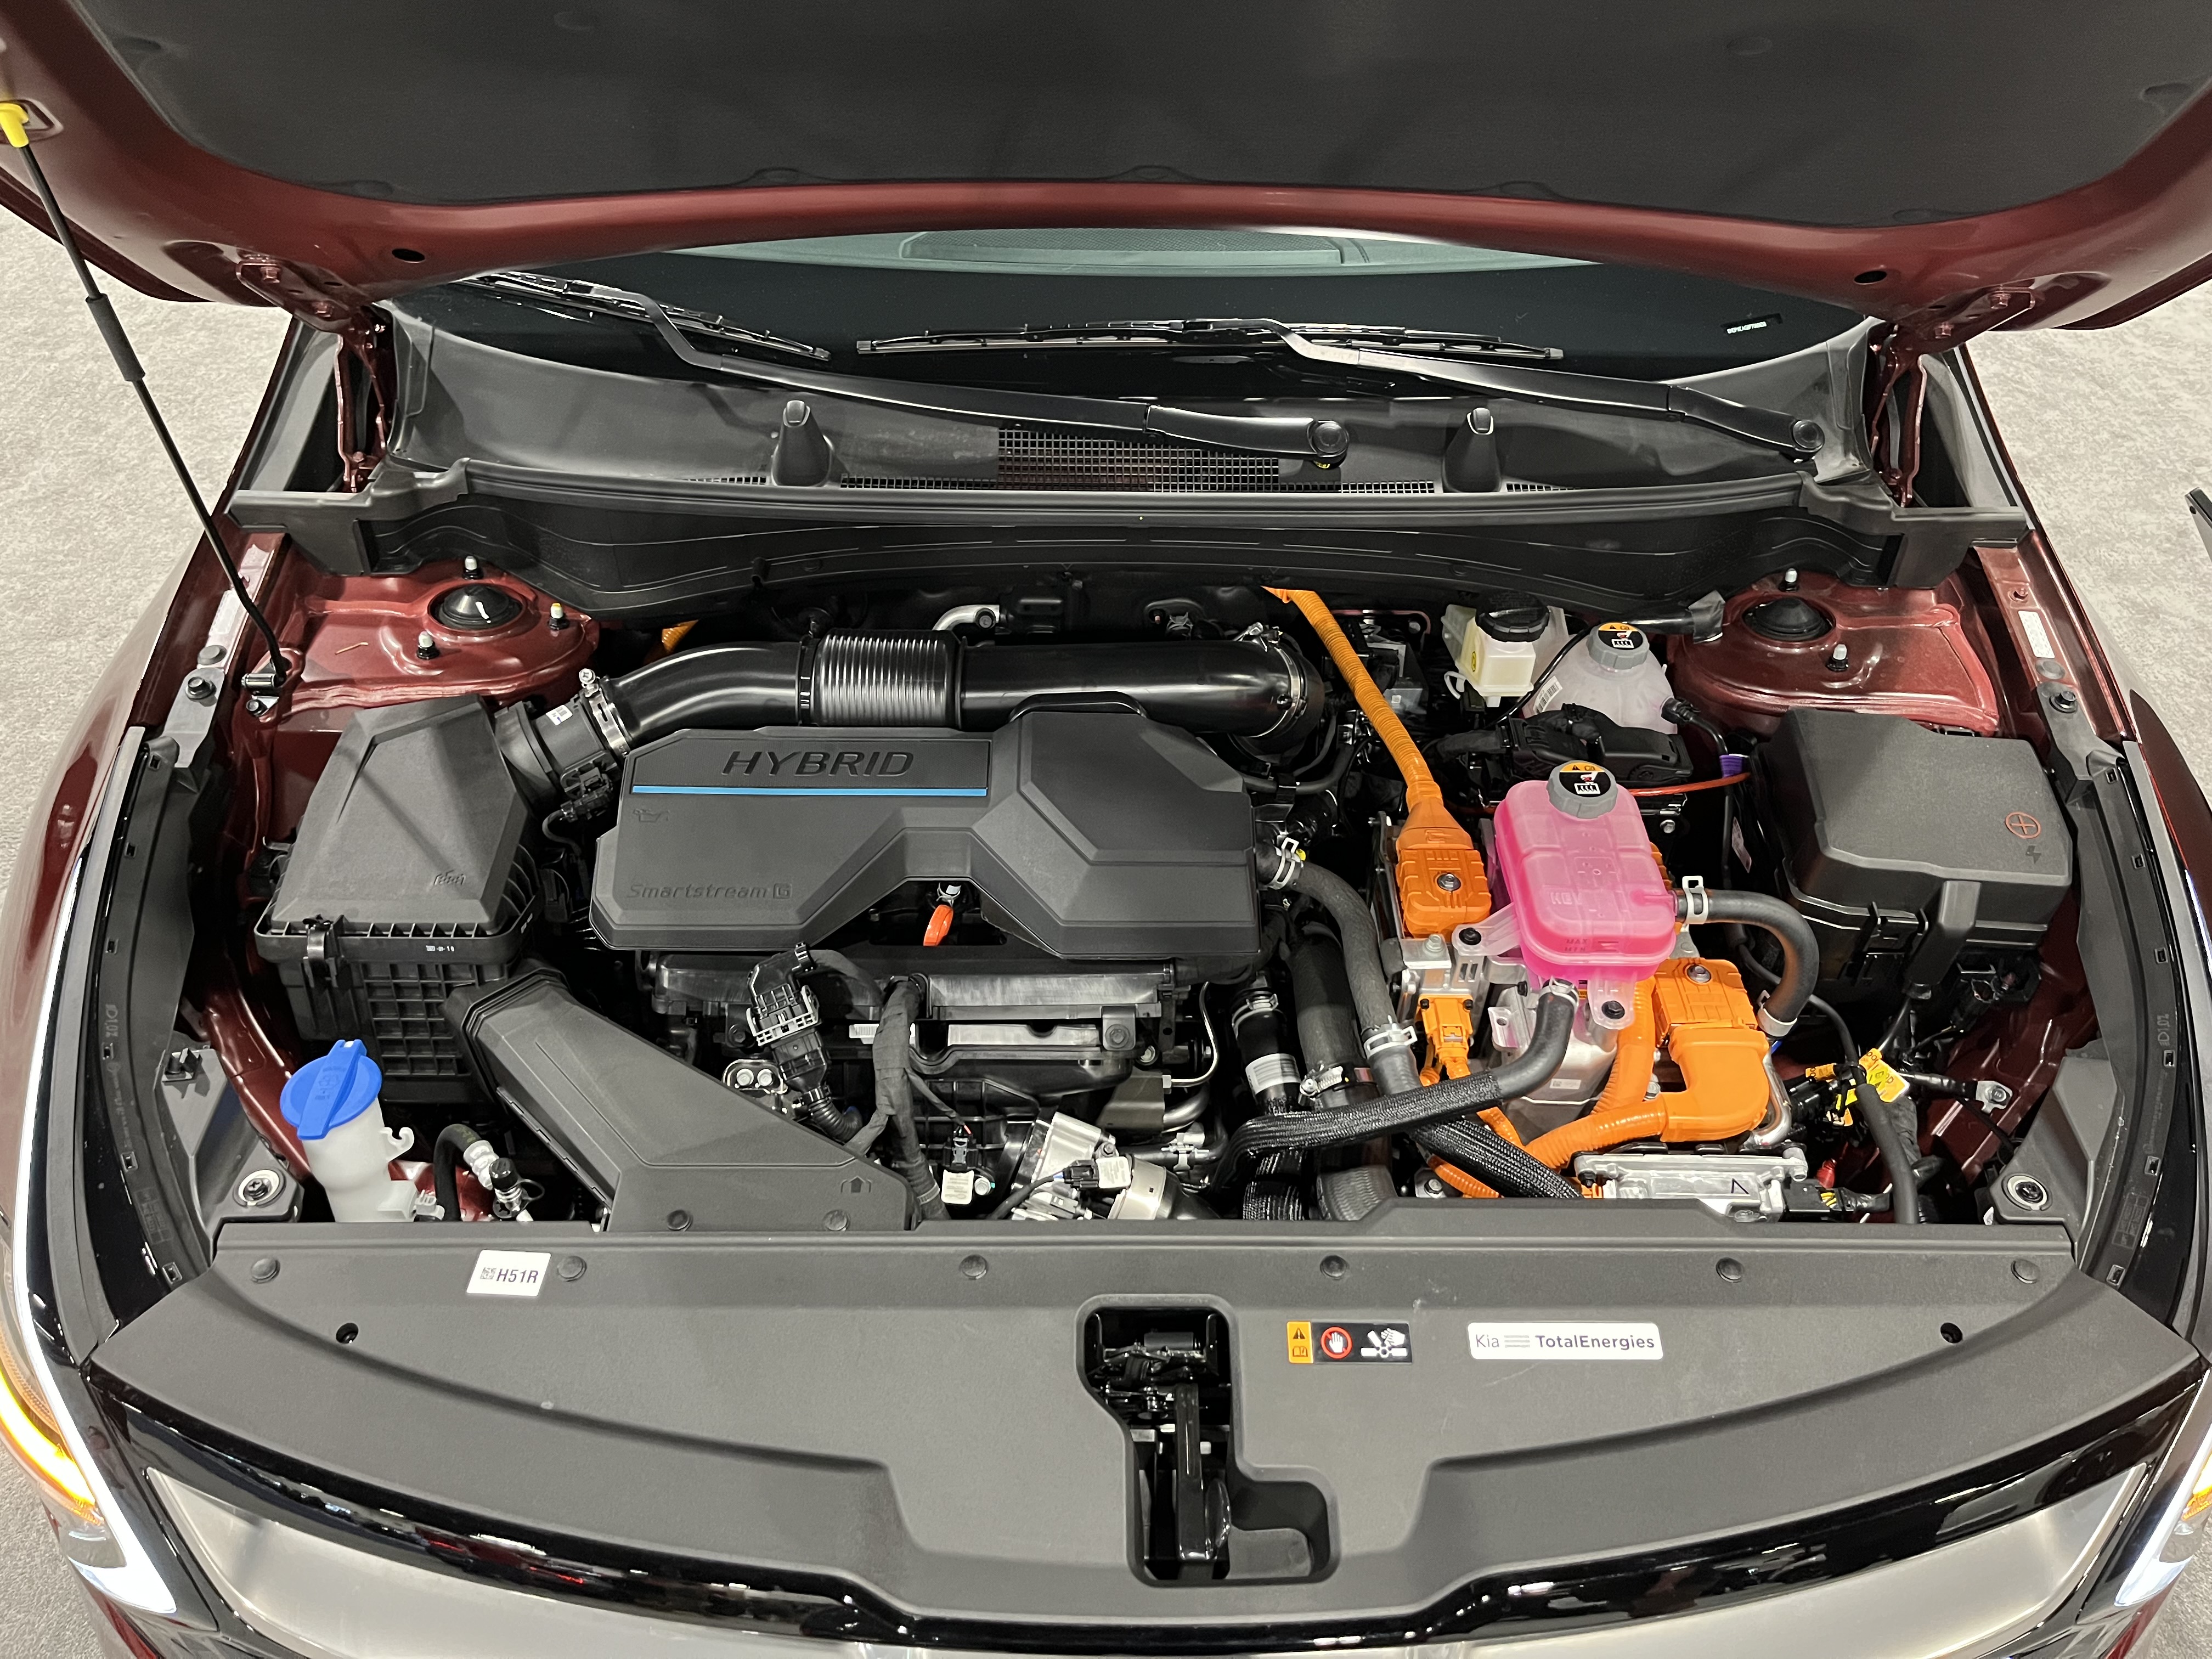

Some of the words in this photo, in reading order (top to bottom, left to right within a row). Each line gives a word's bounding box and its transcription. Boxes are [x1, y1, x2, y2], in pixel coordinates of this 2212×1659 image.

[721, 751, 913, 776] HYBRID
[627, 883, 769, 899] Smartstream
[496, 1268, 539, 1284] H51R
[1475, 1334, 1500, 1348] Kia
[1535, 1335, 1655, 1351] TotalEnergies
